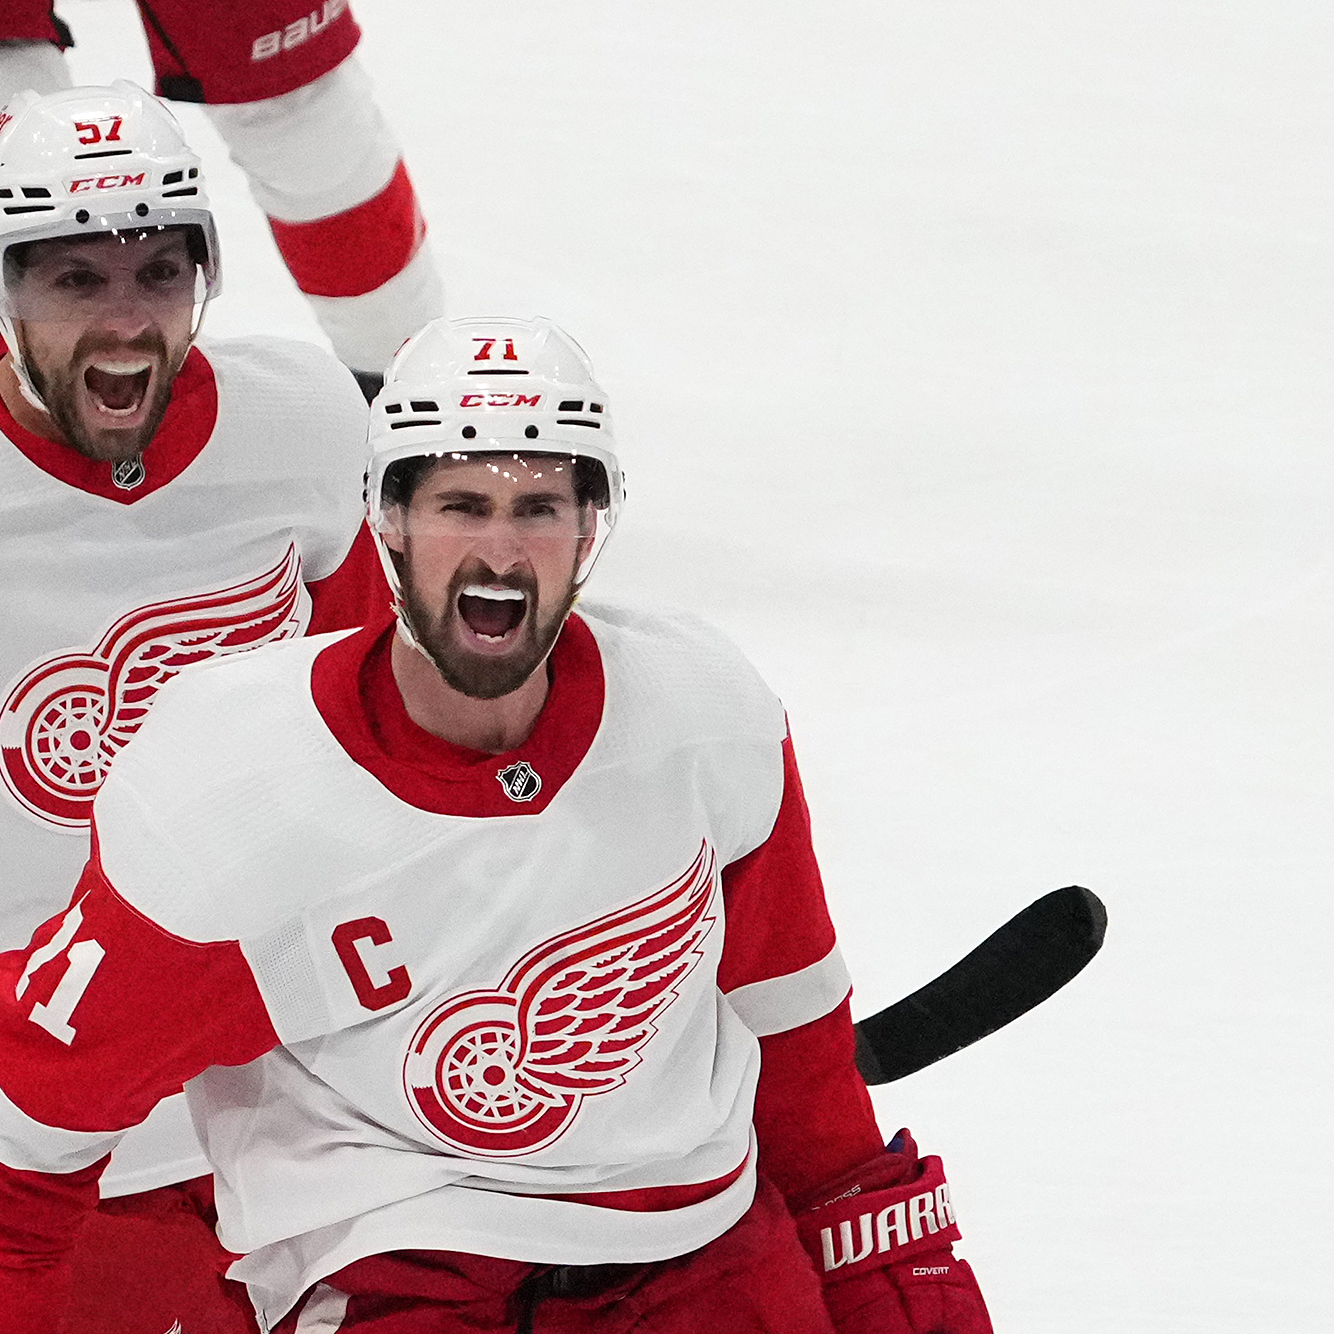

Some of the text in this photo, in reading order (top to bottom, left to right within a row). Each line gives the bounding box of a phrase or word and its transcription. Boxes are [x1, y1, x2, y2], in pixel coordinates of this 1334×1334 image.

[73, 115, 123, 145] 57
[69, 172, 145, 193] CCM
[471, 338, 518, 361] 71
[460, 393, 542, 407] CCM
[331, 916, 412, 1011] C
[912, 1265, 950, 1276] COVERT
